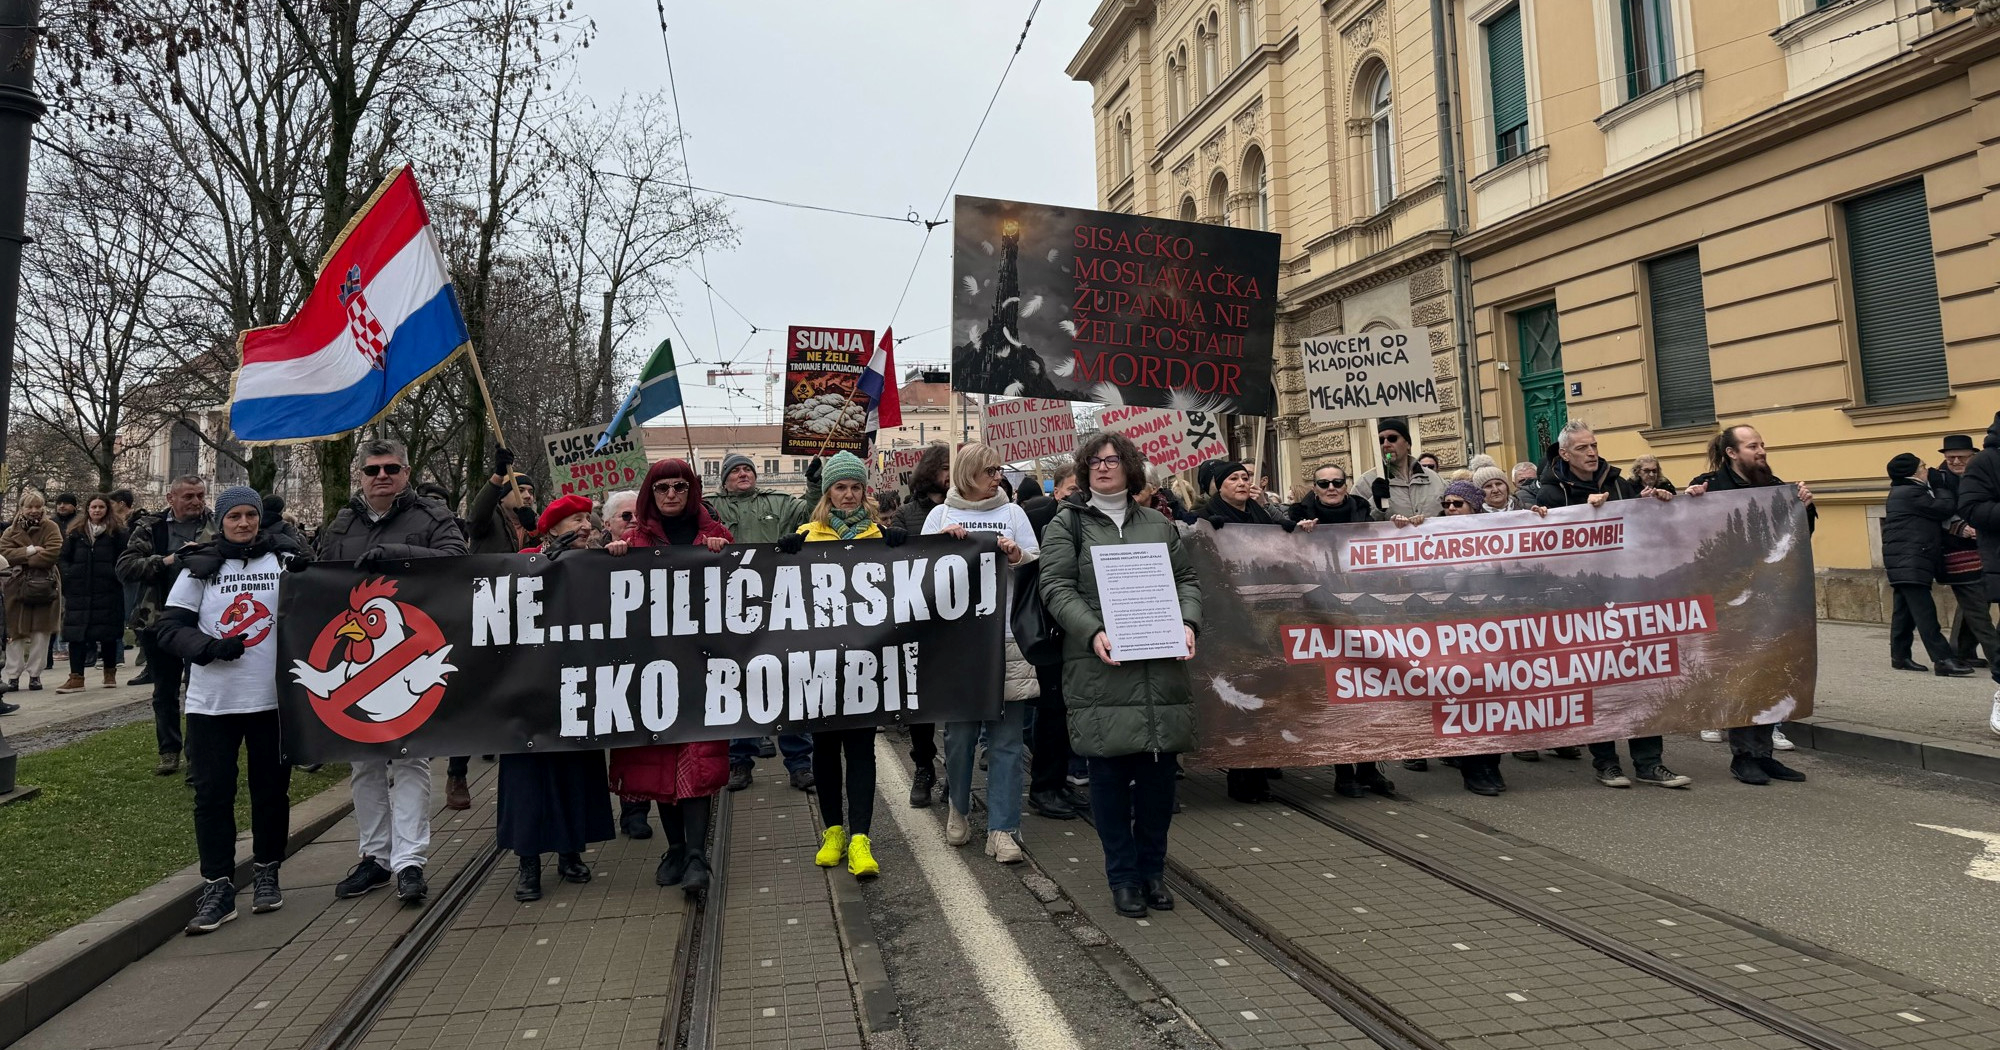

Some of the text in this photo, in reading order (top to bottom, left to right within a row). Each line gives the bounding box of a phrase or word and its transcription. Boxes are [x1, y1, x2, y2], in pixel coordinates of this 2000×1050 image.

[1074, 225, 1193, 260] SISAČKO
[1073, 256, 1262, 300] MOSLAVAČKA
[1072, 280, 1249, 328] ŽUPANIJA NE
[795, 330, 865, 352] SUNJA
[1072, 311, 1245, 358] ŽELI POSTATI
[1304, 334, 1408, 357] NOVCEM OD
[790, 362, 821, 371] TROVANJE
[806, 350, 849, 363] NE ŽELI
[1308, 348, 1409, 374] KLADIONICA
[1072, 349, 1242, 396] MORDOR
[1345, 371, 1368, 382] DO
[1309, 377, 1438, 410] MEGAKLAONICA
[988, 401, 1021, 418] NITKO
[1023, 398, 1038, 413] NE
[987, 413, 1076, 441] ŽIVJETI U SMRADU
[1119, 412, 1173, 440] MONIJAK
[1177, 410, 1183, 422] I
[1171, 430, 1184, 444] U
[548, 433, 594, 457] FUCK
[788, 439, 817, 448] SPASIMO
[836, 441, 862, 450] SUNJU!
[1002, 434, 1074, 462] ZAGAĐENJU!
[1167, 441, 1227, 474] VODAMA
[561, 467, 635, 495] NAROD
[570, 459, 617, 479] ŽIVIO
[1350, 523, 1624, 566] NE PILIĆARSKOJ EKO BOMBI!
[220, 582, 275, 594] EKO BOMBI!
[1288, 599, 1707, 660] ZAJEDNO PROTIV UNIŠTENJA
[1335, 641, 1672, 699] SISAČKO-MOSLAVAČKE
[559, 641, 920, 739] EKO BOMBI!
[1440, 693, 1585, 735] ŽUPANIJE
